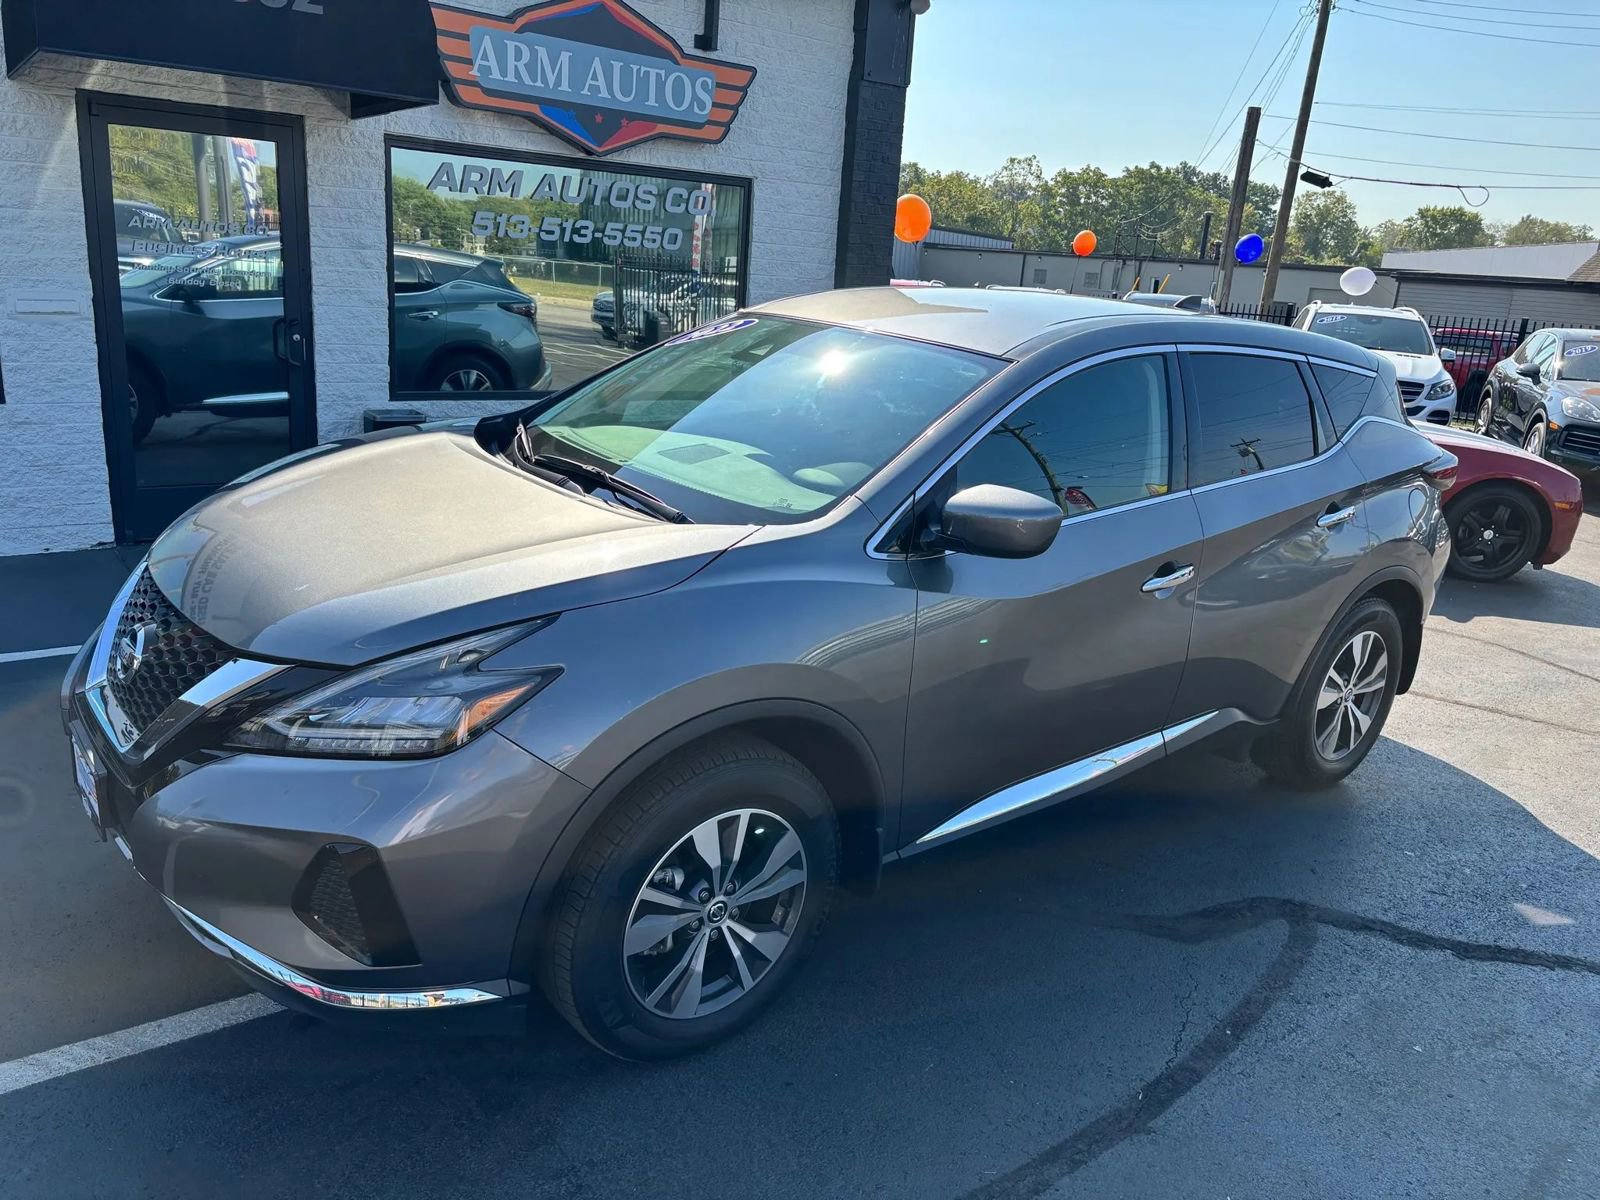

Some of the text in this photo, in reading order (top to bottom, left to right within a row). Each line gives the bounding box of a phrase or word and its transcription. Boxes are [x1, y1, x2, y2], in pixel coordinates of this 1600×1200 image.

[469, 34, 713, 115] ARM AUTOS
[426, 162, 524, 199] ARM
[530, 173, 659, 211] AUTOS
[127, 215, 173, 230] ARM
[174, 217, 242, 234] AUTOS
[471, 210, 684, 251] 513-513-5550
[131, 238, 213, 257] Business
[166, 277, 242, 289] Sunday Closed
[1567, 343, 1591, 356] 2019
